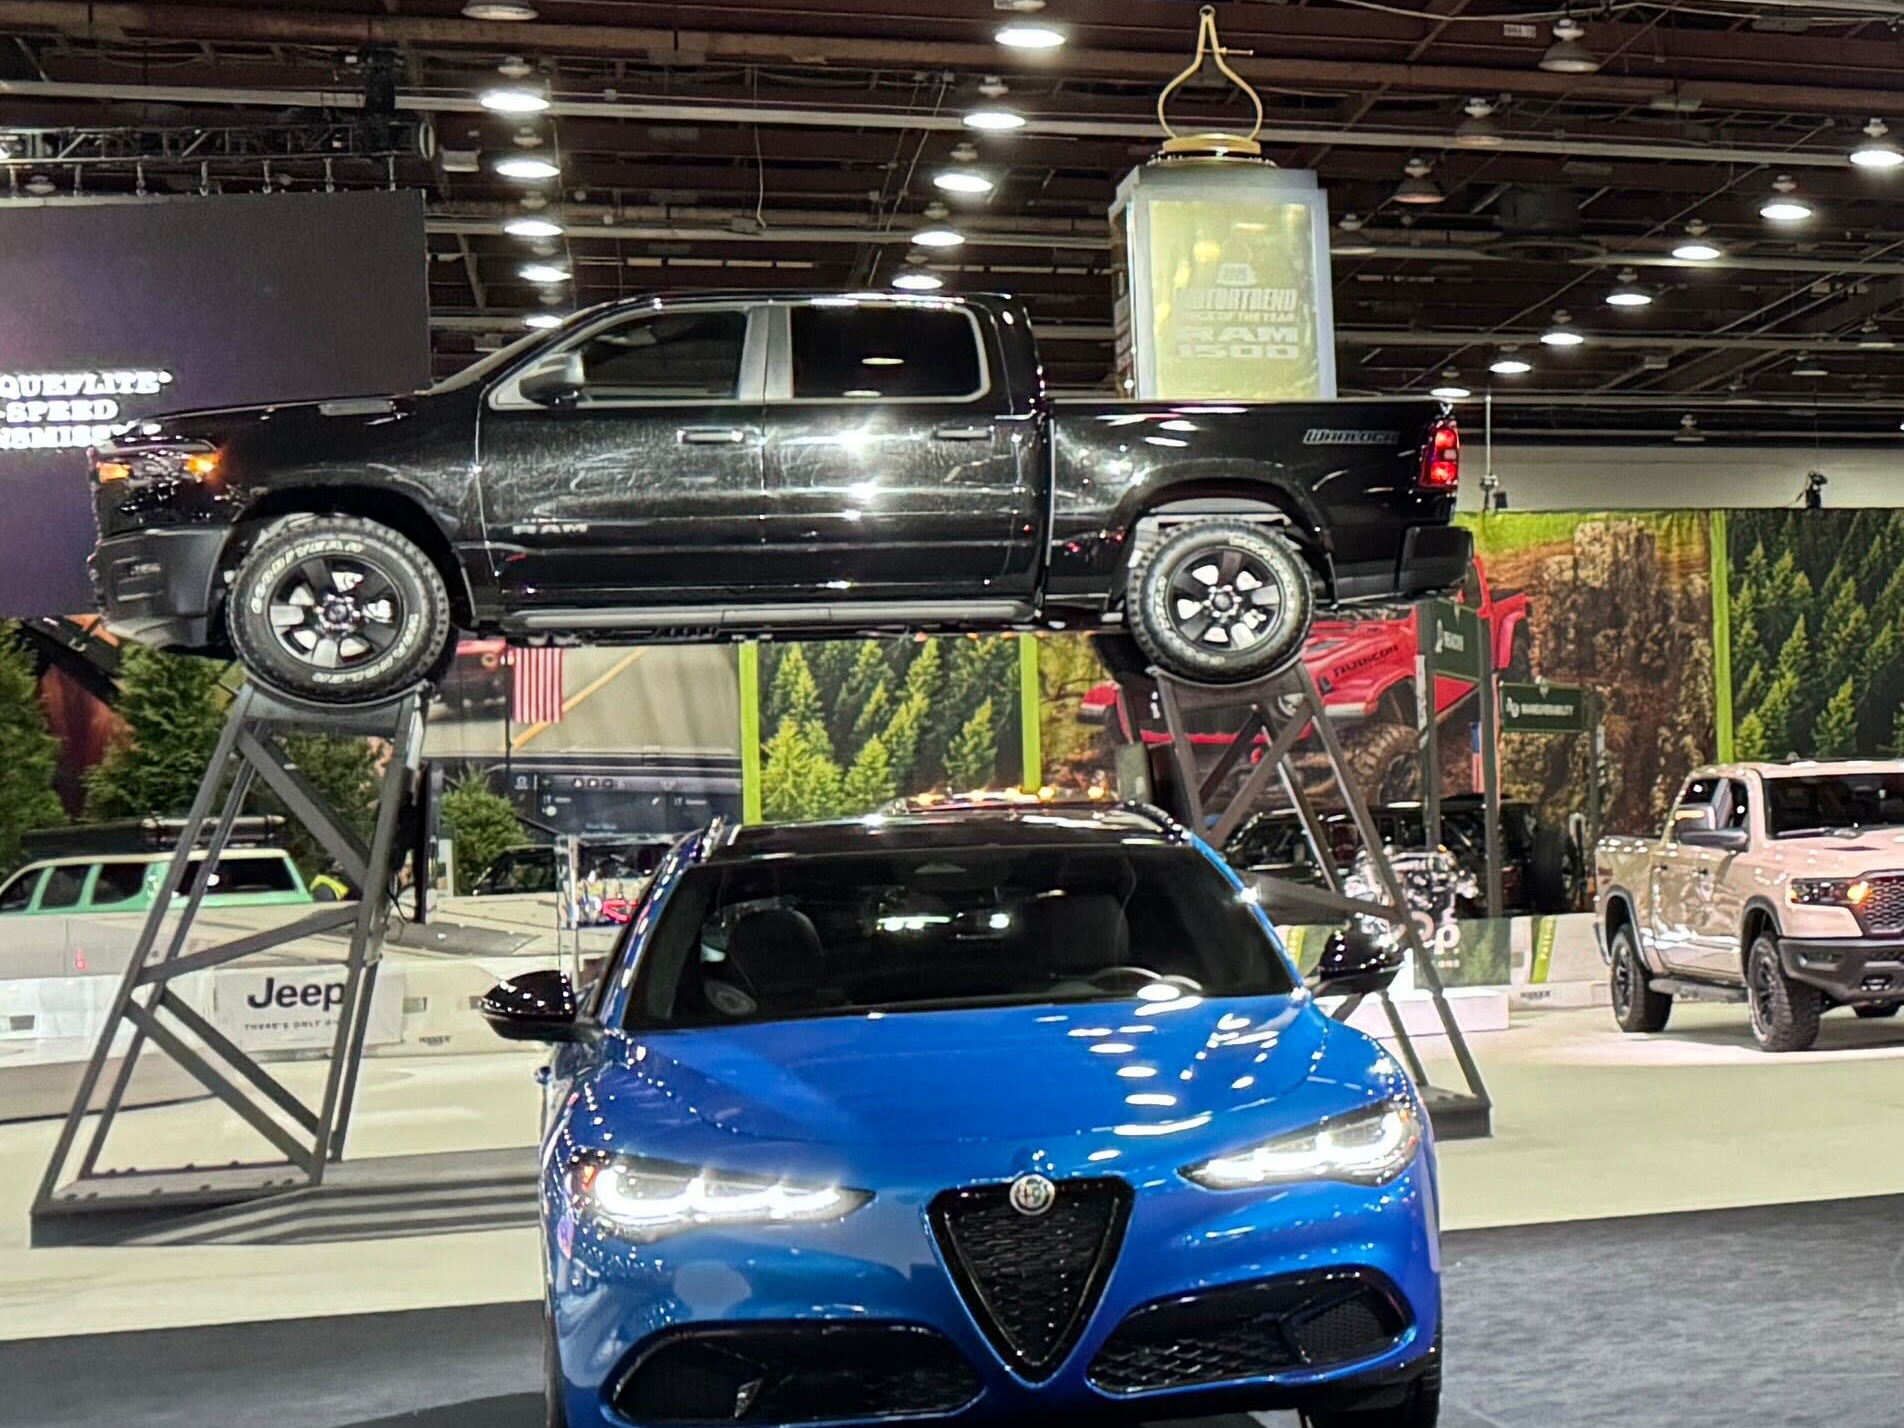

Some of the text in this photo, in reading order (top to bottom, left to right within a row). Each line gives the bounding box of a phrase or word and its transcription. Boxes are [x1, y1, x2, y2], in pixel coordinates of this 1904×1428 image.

[1176, 326, 1299, 343] RAM
[1177, 344, 1299, 360] 1500
[246, 976, 346, 1012] Jeep
